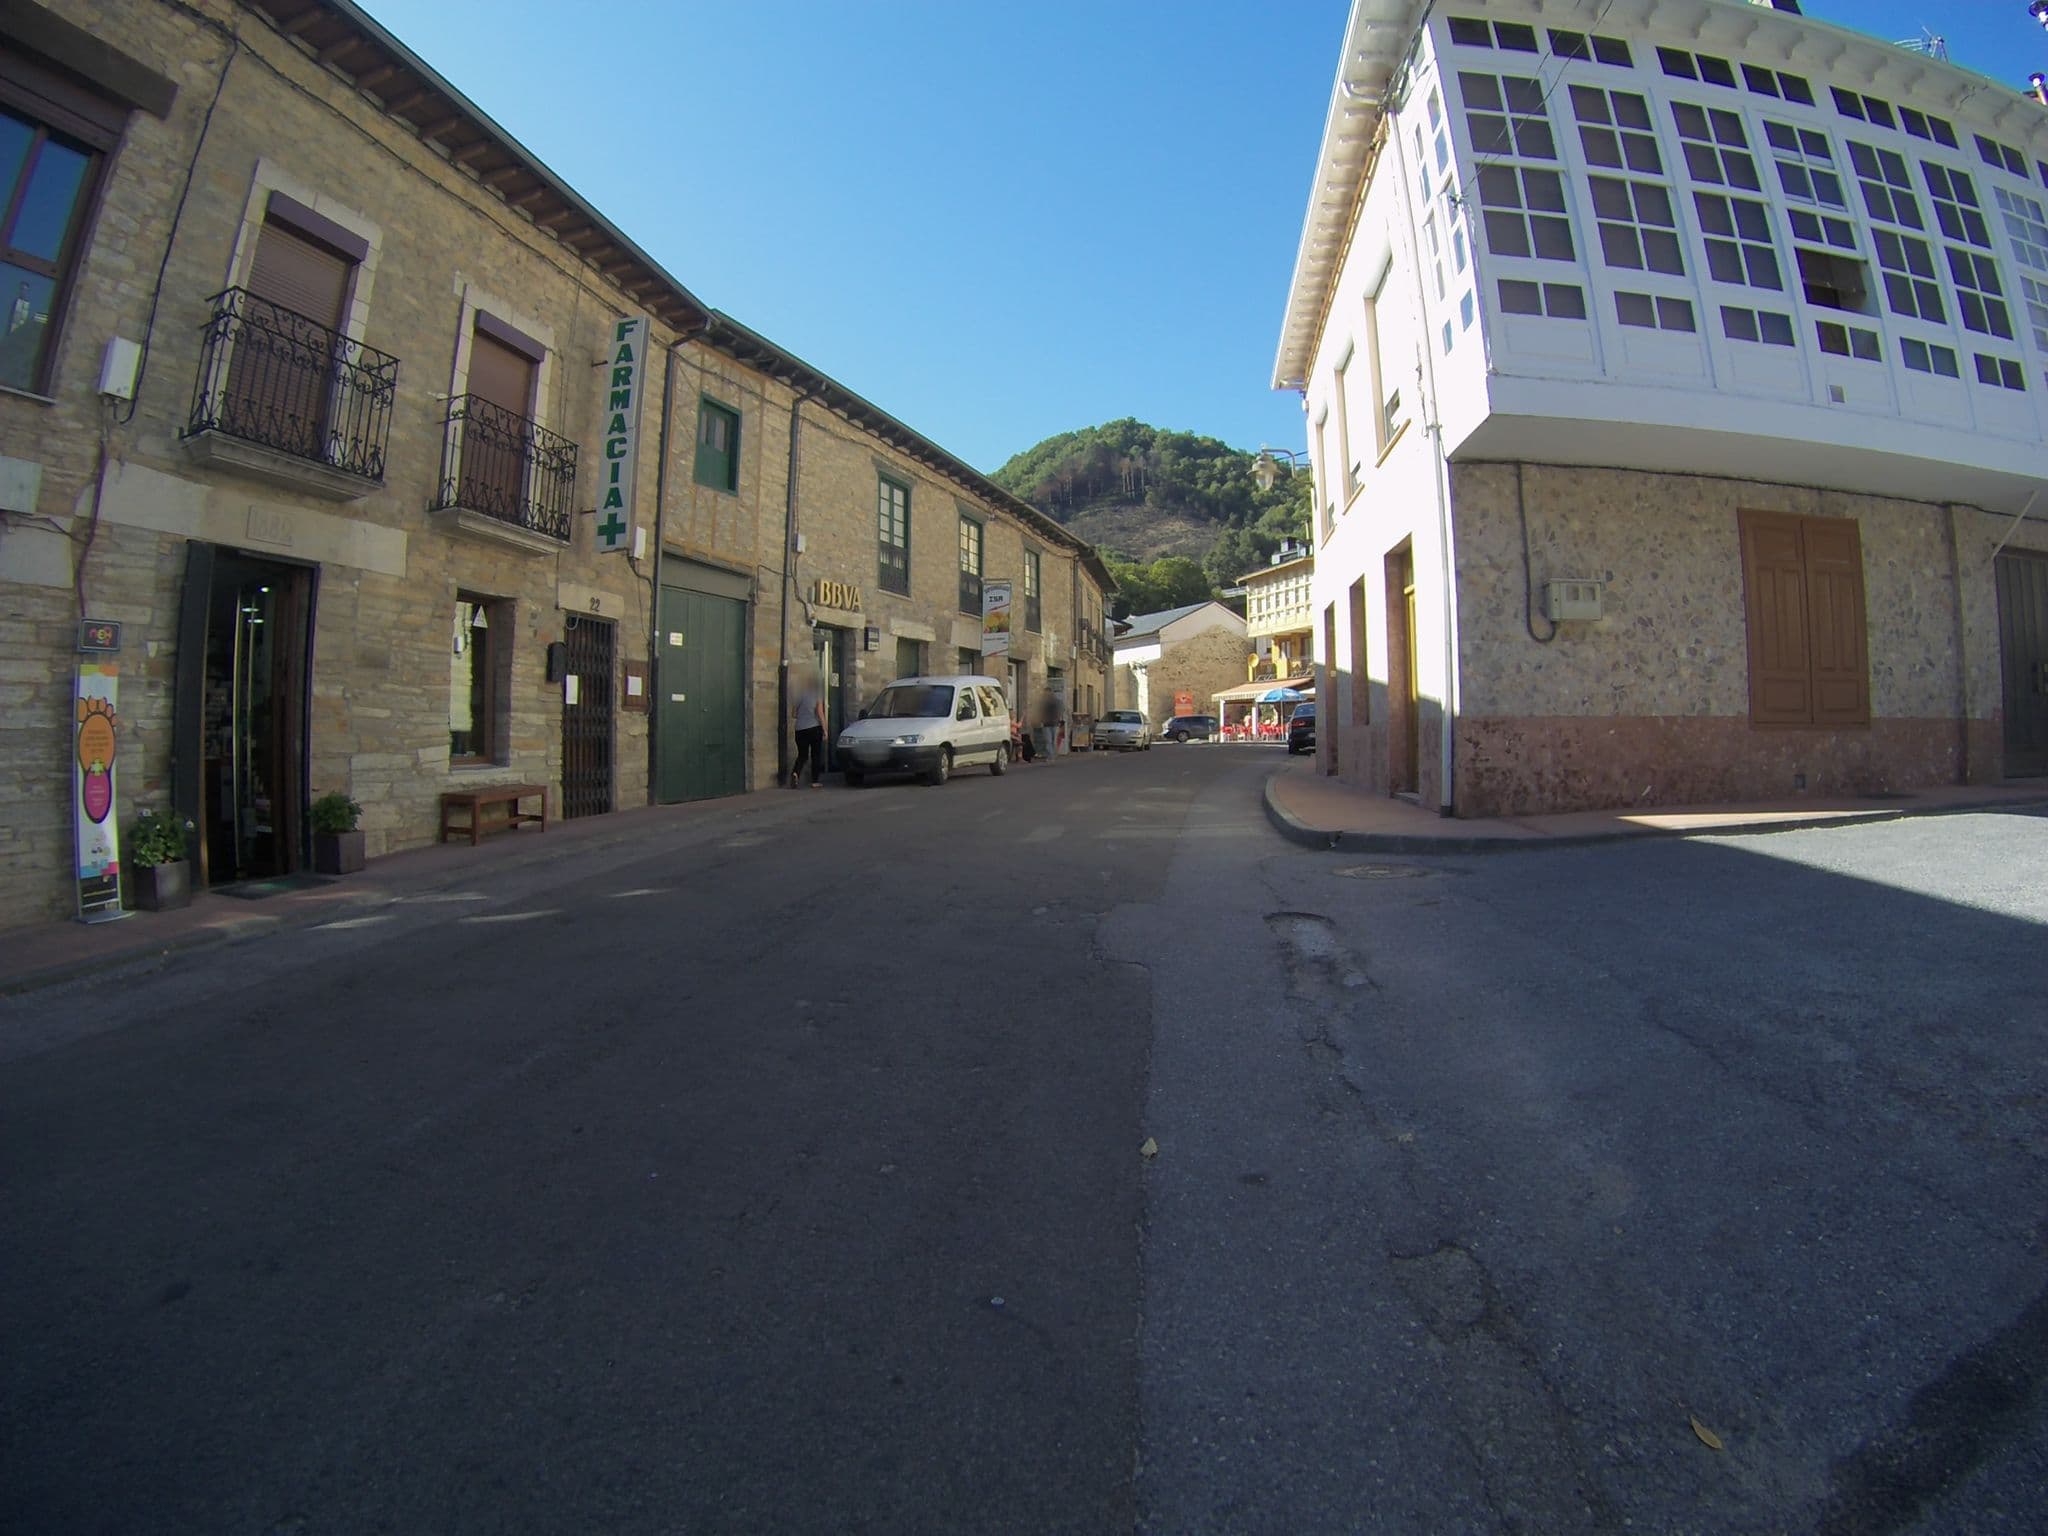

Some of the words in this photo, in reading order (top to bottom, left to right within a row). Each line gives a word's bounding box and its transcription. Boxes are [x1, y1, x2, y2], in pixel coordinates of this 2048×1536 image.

[602, 319, 638, 510] FARMACIA
[589, 596, 601, 612] 22
[816, 578, 862, 612] BBVA
